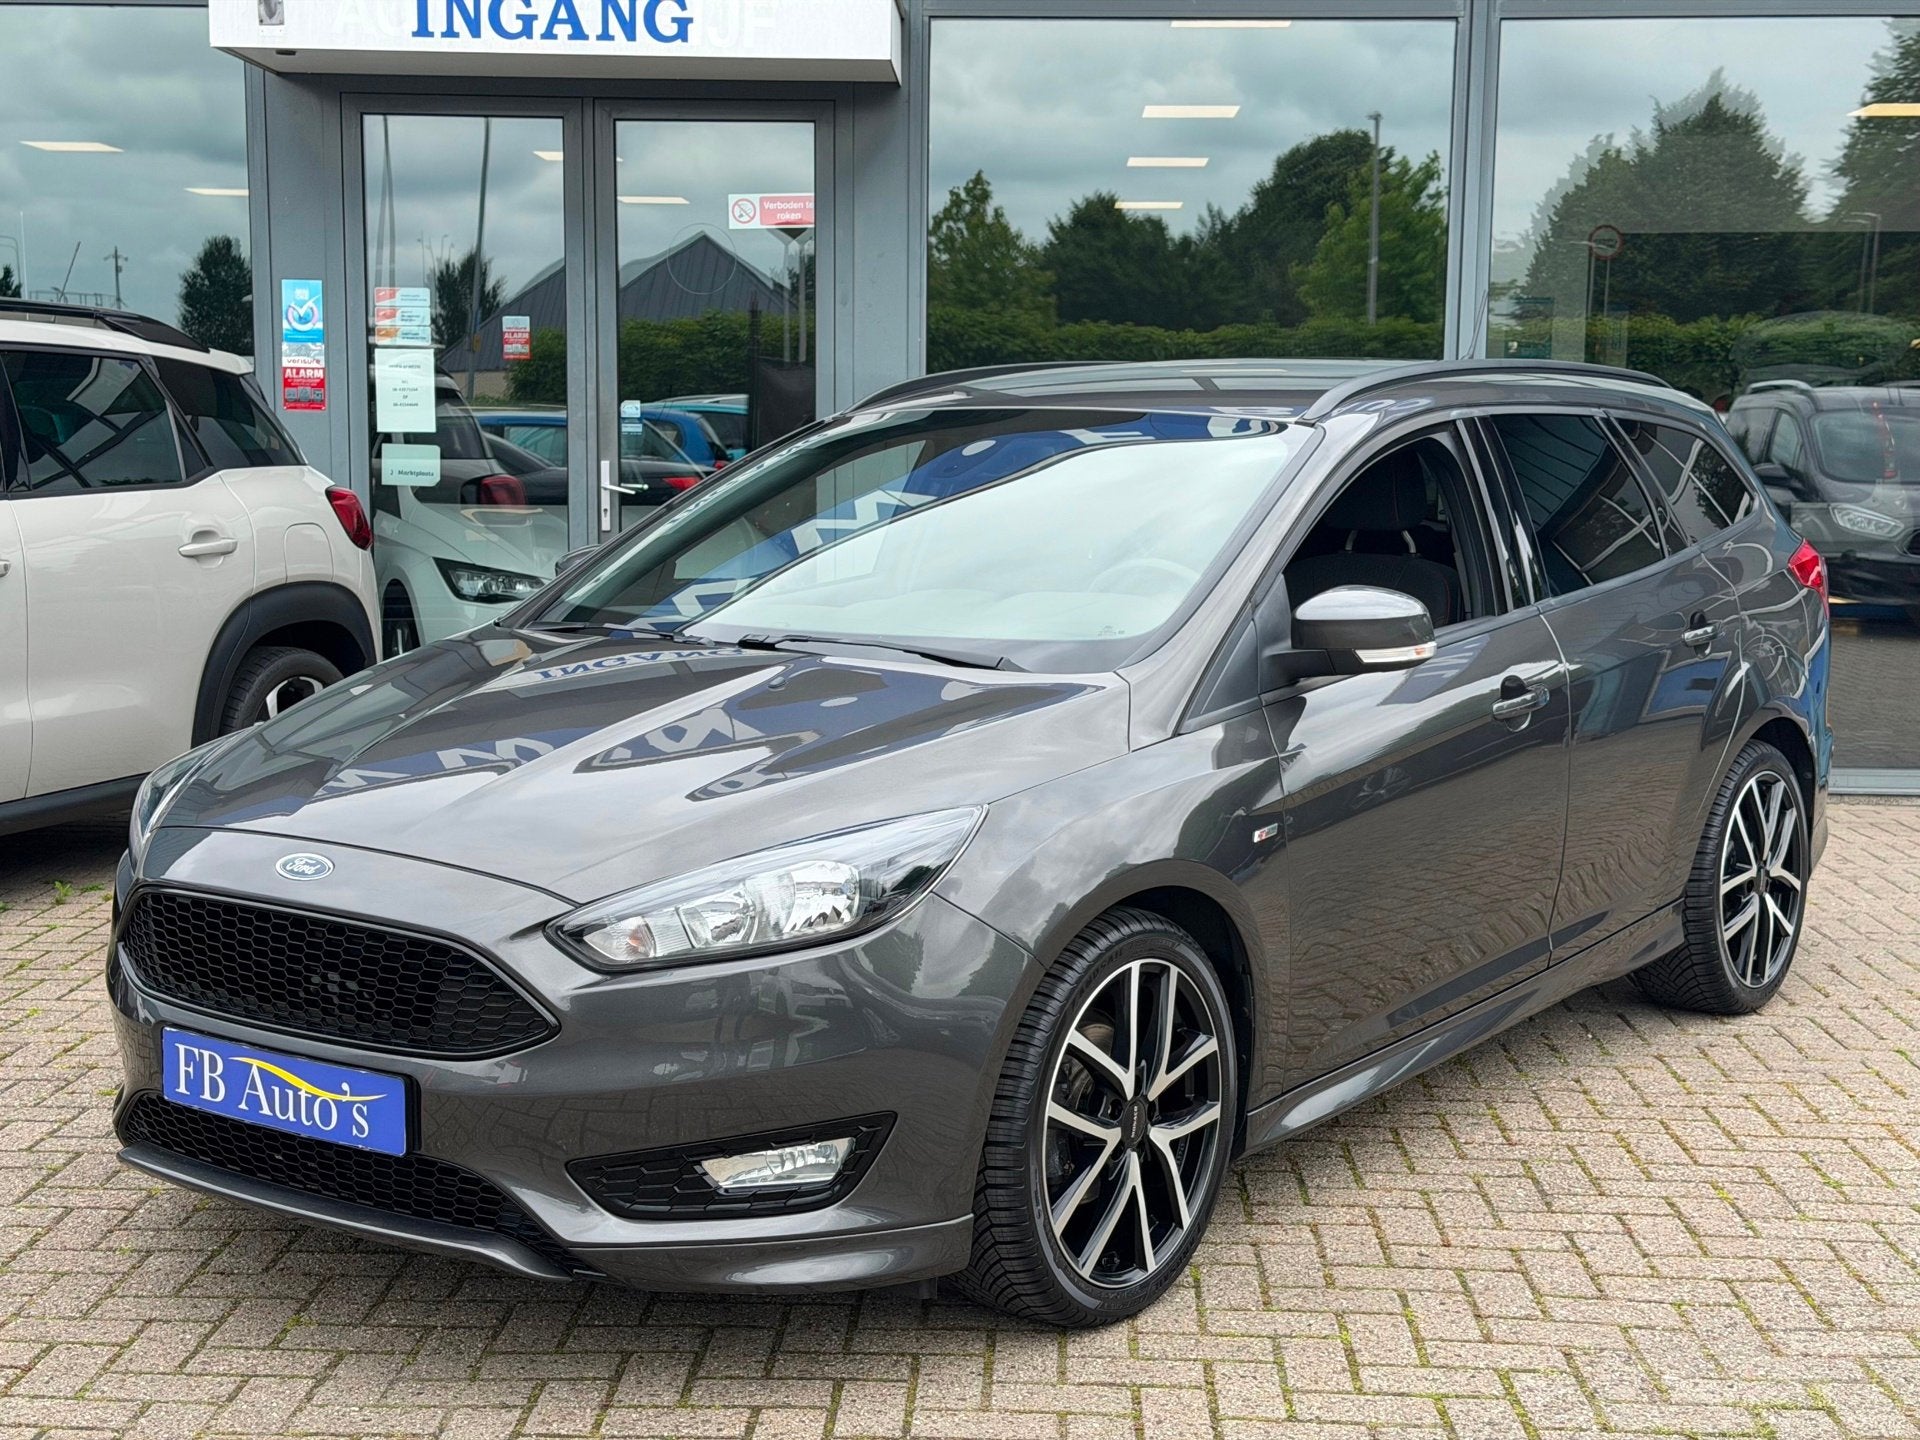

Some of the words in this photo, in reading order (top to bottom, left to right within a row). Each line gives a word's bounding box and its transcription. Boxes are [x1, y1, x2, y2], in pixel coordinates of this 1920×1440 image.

[411, 0, 695, 43] INGANG
[763, 201, 804, 210] Verboden
[777, 212, 801, 220] roken
[285, 368, 324, 379] ALARM
[285, 857, 322, 875] Ford
[174, 1043, 226, 1102] FB
[237, 1063, 369, 1138] Auto's
